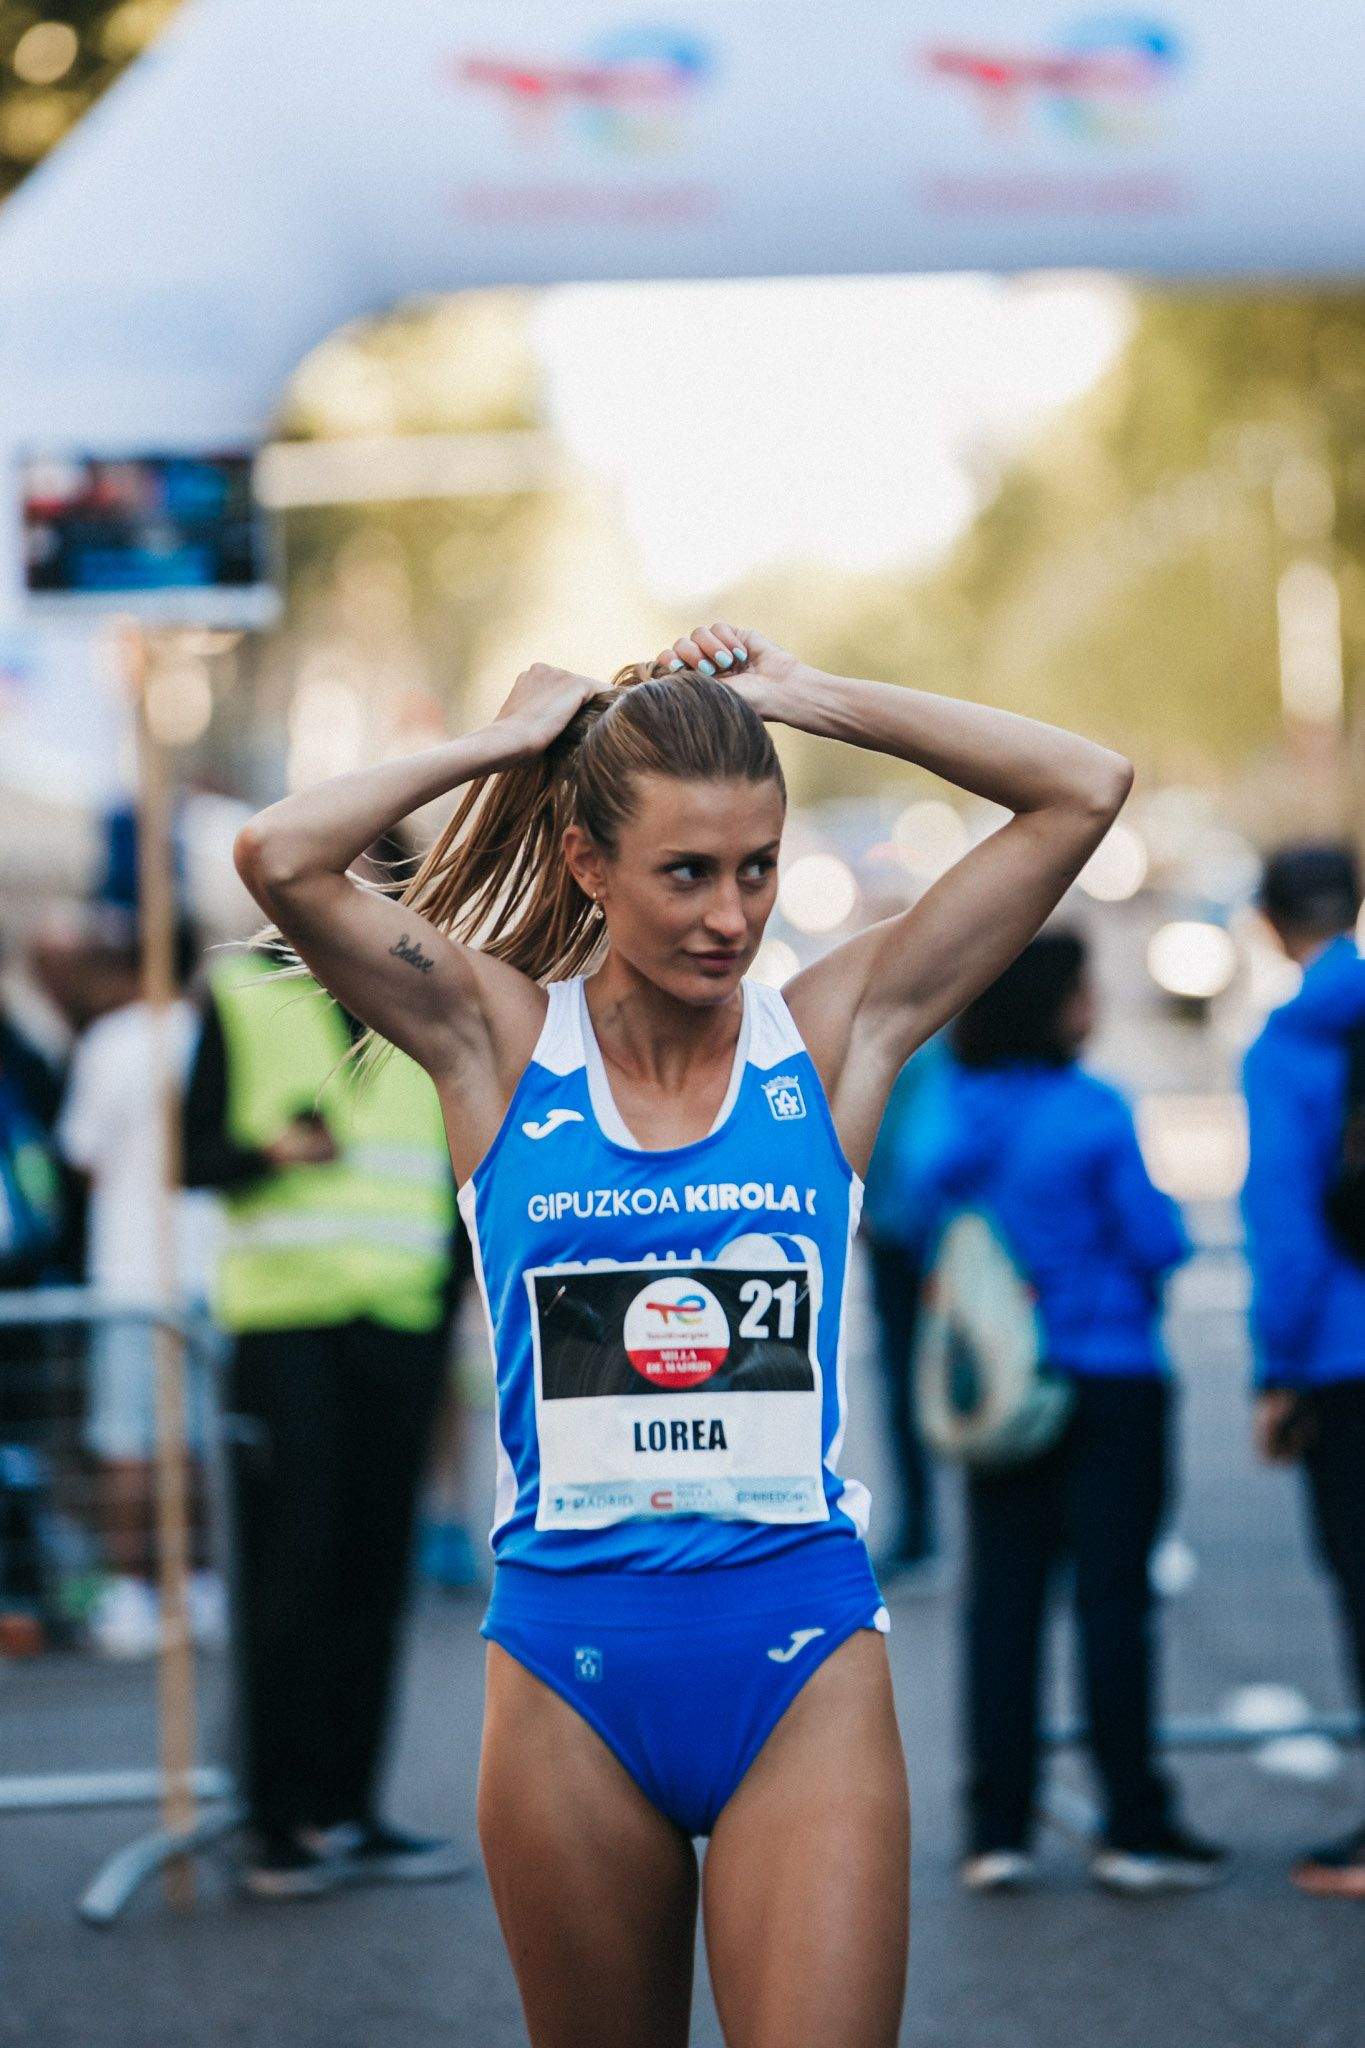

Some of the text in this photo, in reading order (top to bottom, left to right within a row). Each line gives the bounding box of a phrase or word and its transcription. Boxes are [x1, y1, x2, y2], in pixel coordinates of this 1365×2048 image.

[527, 1187, 679, 1223] GIPUZKOA
[684, 1182, 801, 1213] KIROLA
[739, 1279, 797, 1339] 21
[633, 1419, 728, 1452] LOREA
